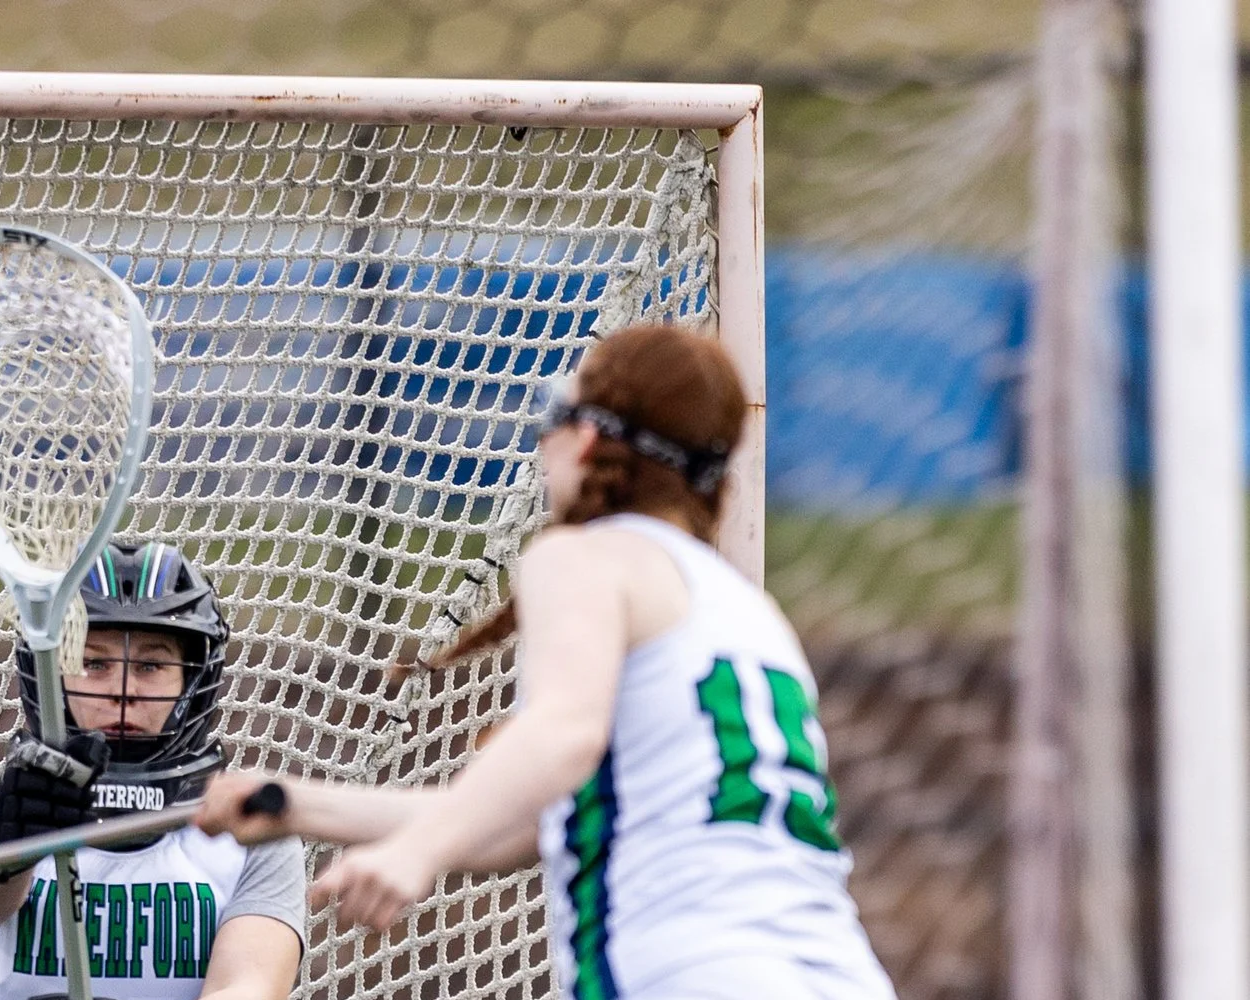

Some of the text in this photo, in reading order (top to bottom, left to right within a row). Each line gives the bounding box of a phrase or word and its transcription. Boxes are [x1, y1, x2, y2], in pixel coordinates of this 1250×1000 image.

[2, 228, 49, 248] STX
[696, 657, 839, 853] 15
[13, 877, 217, 979] WAERFORD
